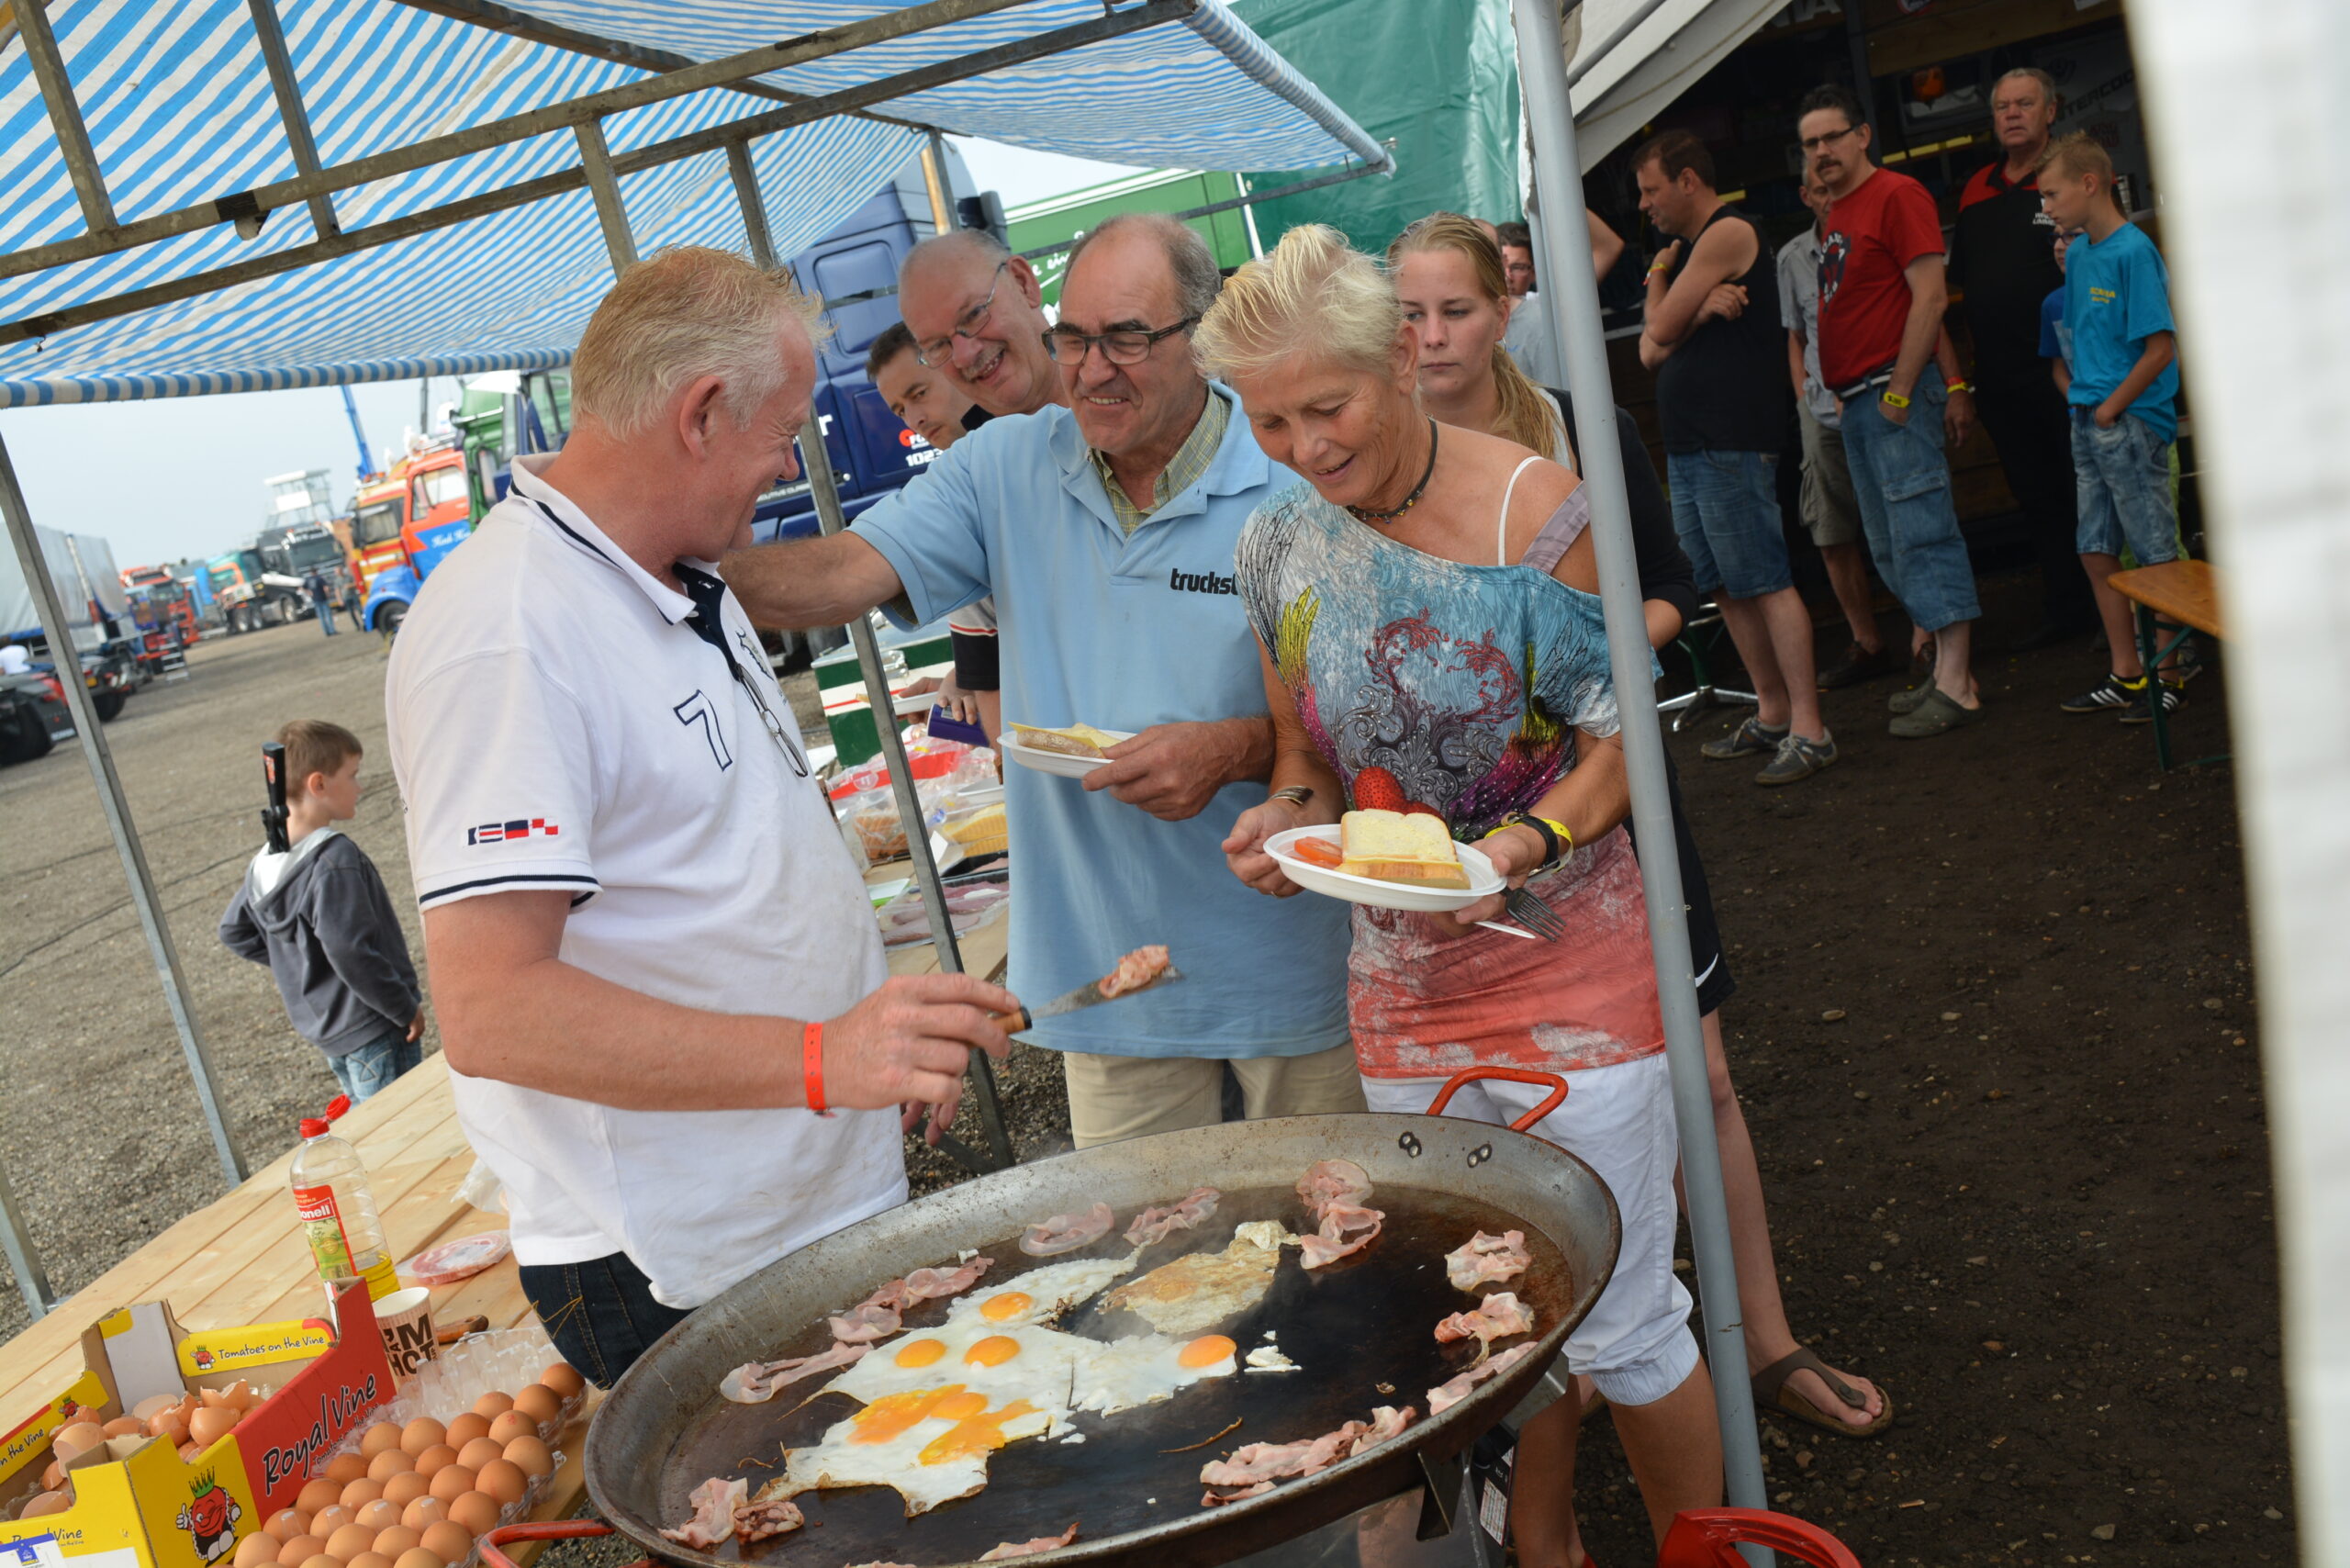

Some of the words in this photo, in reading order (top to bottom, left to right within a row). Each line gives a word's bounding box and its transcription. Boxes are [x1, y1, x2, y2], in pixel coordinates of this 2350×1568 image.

[673, 689, 733, 772] 7
[300, 1204, 331, 1219] onell
[218, 1344, 265, 1360] Tomatoes
[268, 1344, 283, 1352] on
[284, 1337, 301, 1349] the
[302, 1336, 325, 1347] Vine
[7, 1444, 25, 1459] the
[24, 1428, 45, 1447] Vine
[263, 1394, 329, 1496] Royal
[332, 1373, 376, 1428] Vine
[53, 1528, 84, 1542] Vine
